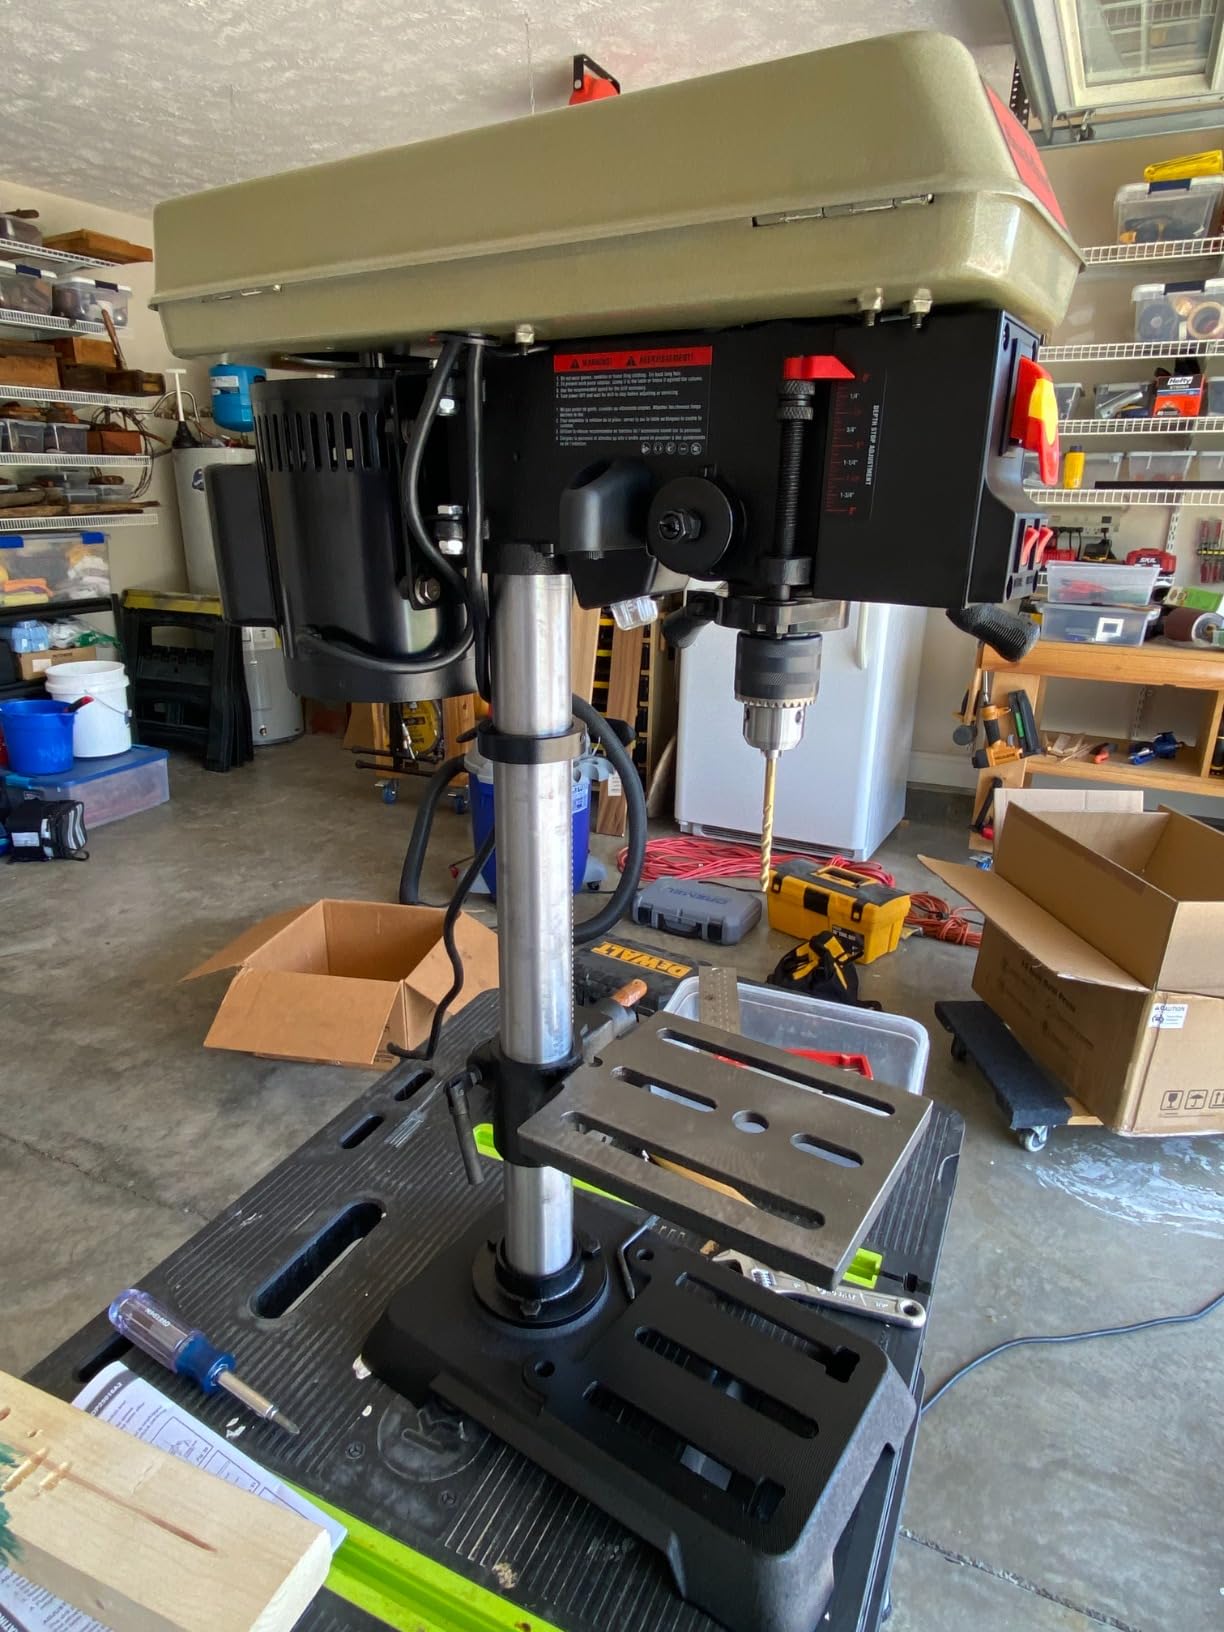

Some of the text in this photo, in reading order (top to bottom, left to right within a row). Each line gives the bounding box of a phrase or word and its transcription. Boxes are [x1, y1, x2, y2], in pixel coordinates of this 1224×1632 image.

[865, 404, 880, 486] DEPTH STOP ADJUSTMENT
[591, 941, 693, 979] DEWALT
